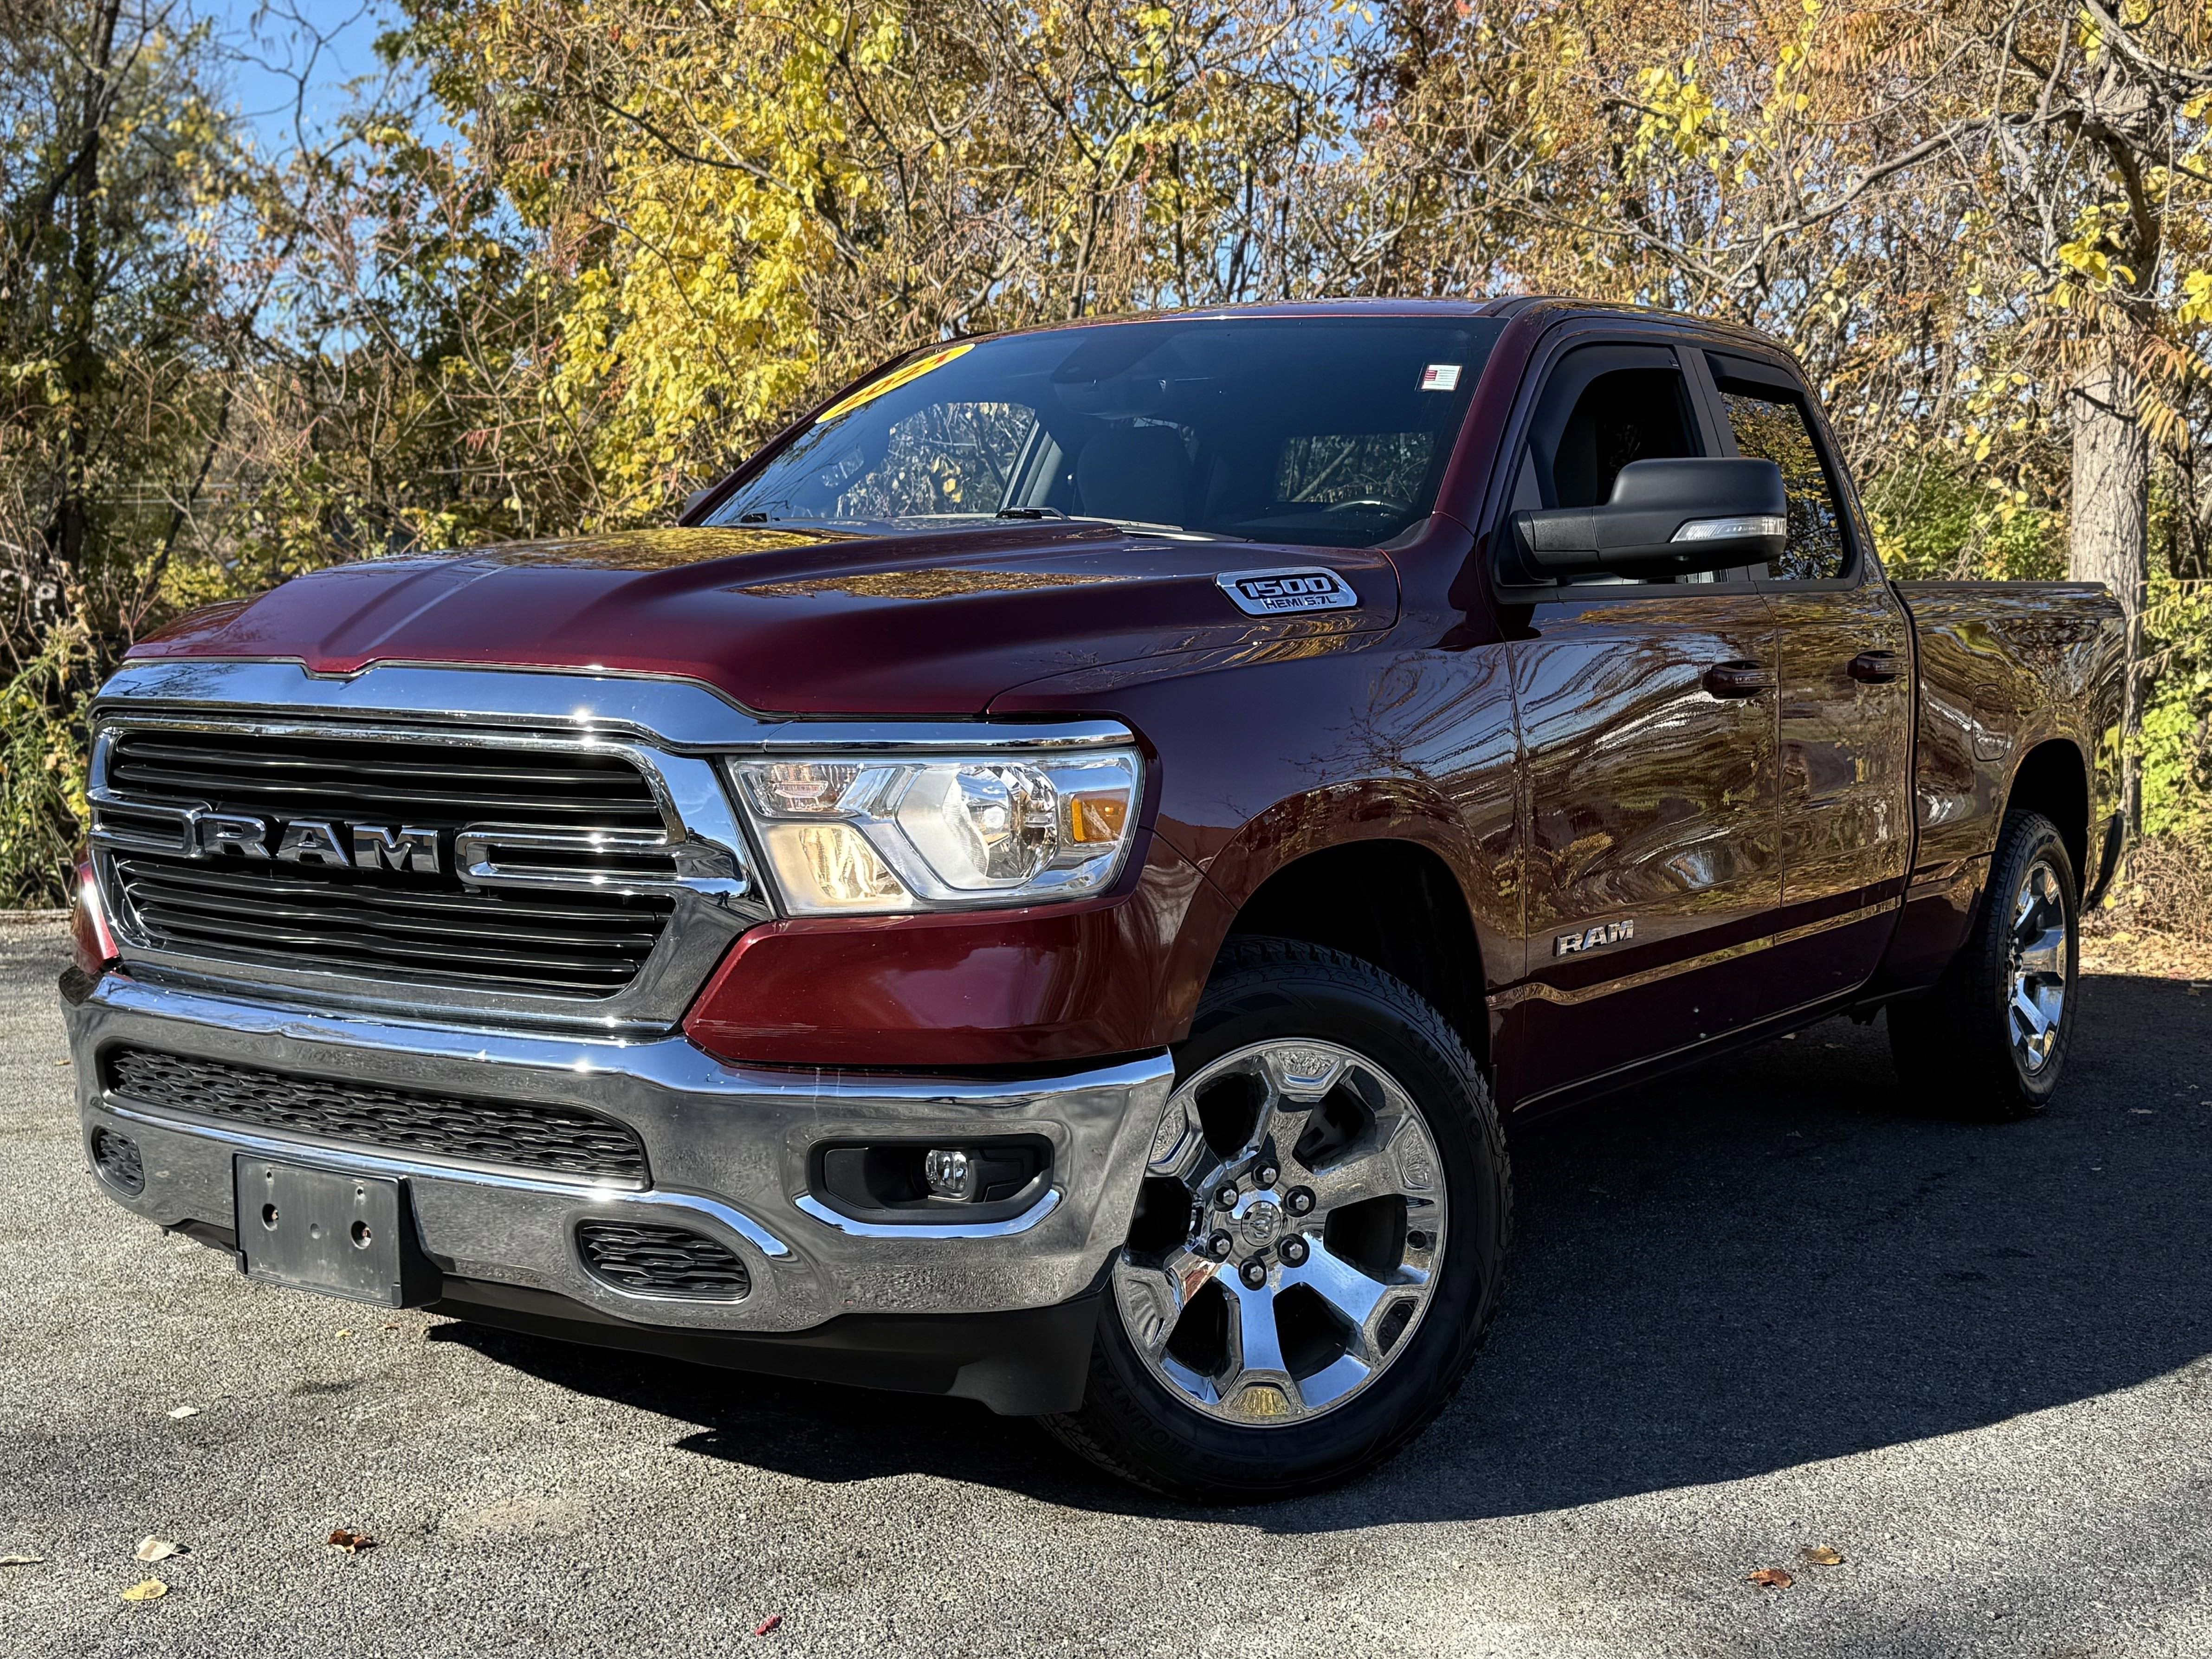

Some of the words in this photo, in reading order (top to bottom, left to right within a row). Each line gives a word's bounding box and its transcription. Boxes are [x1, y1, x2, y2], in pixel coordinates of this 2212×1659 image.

[835, 351, 951, 414] 2021
[1239, 576, 1332, 598] 1500
[1263, 598, 1303, 609] HEMI
[1305, 595, 1337, 606] 5.7L
[202, 813, 440, 873] RAM
[1556, 919, 1634, 957] RAM
[1401, 1021, 1483, 1142] KUMHO
